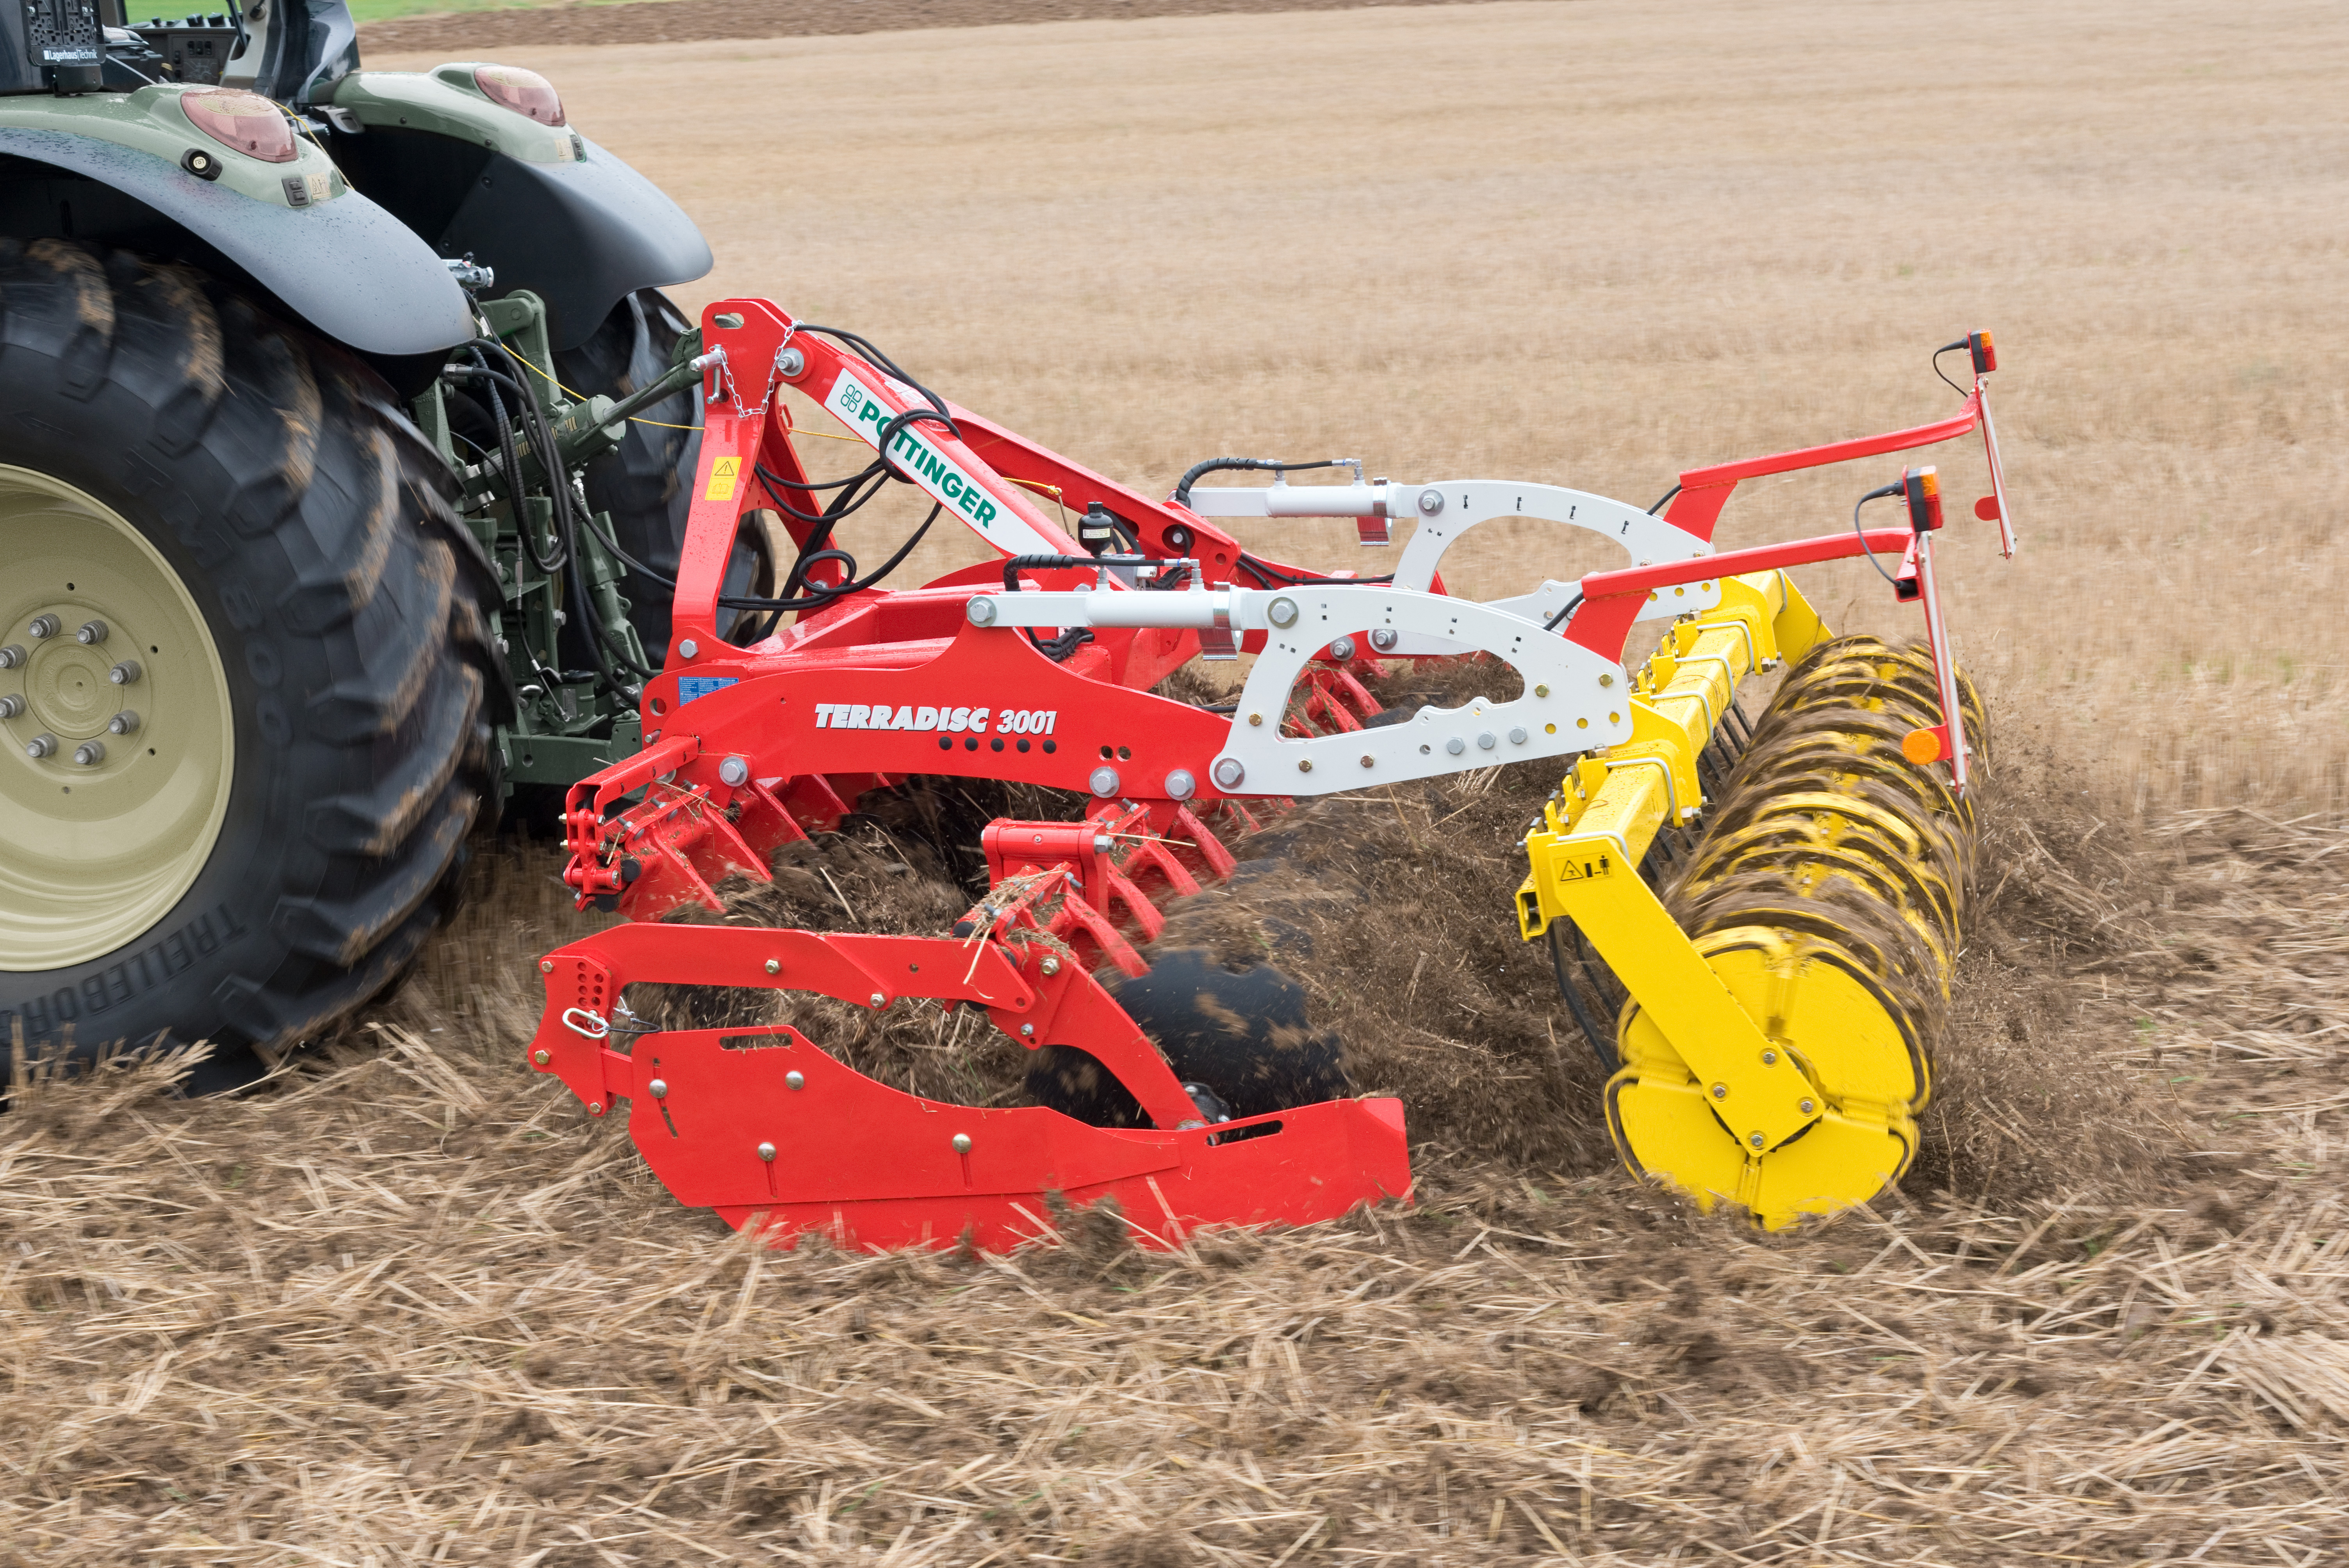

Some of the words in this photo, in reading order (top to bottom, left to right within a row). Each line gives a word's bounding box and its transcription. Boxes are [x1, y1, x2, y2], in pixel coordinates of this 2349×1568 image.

[49, 50, 78, 62] Lagerhaus
[78, 49, 98, 59] Technik
[814, 703, 990, 733] TERRADISC
[996, 709, 1057, 735] 3001
